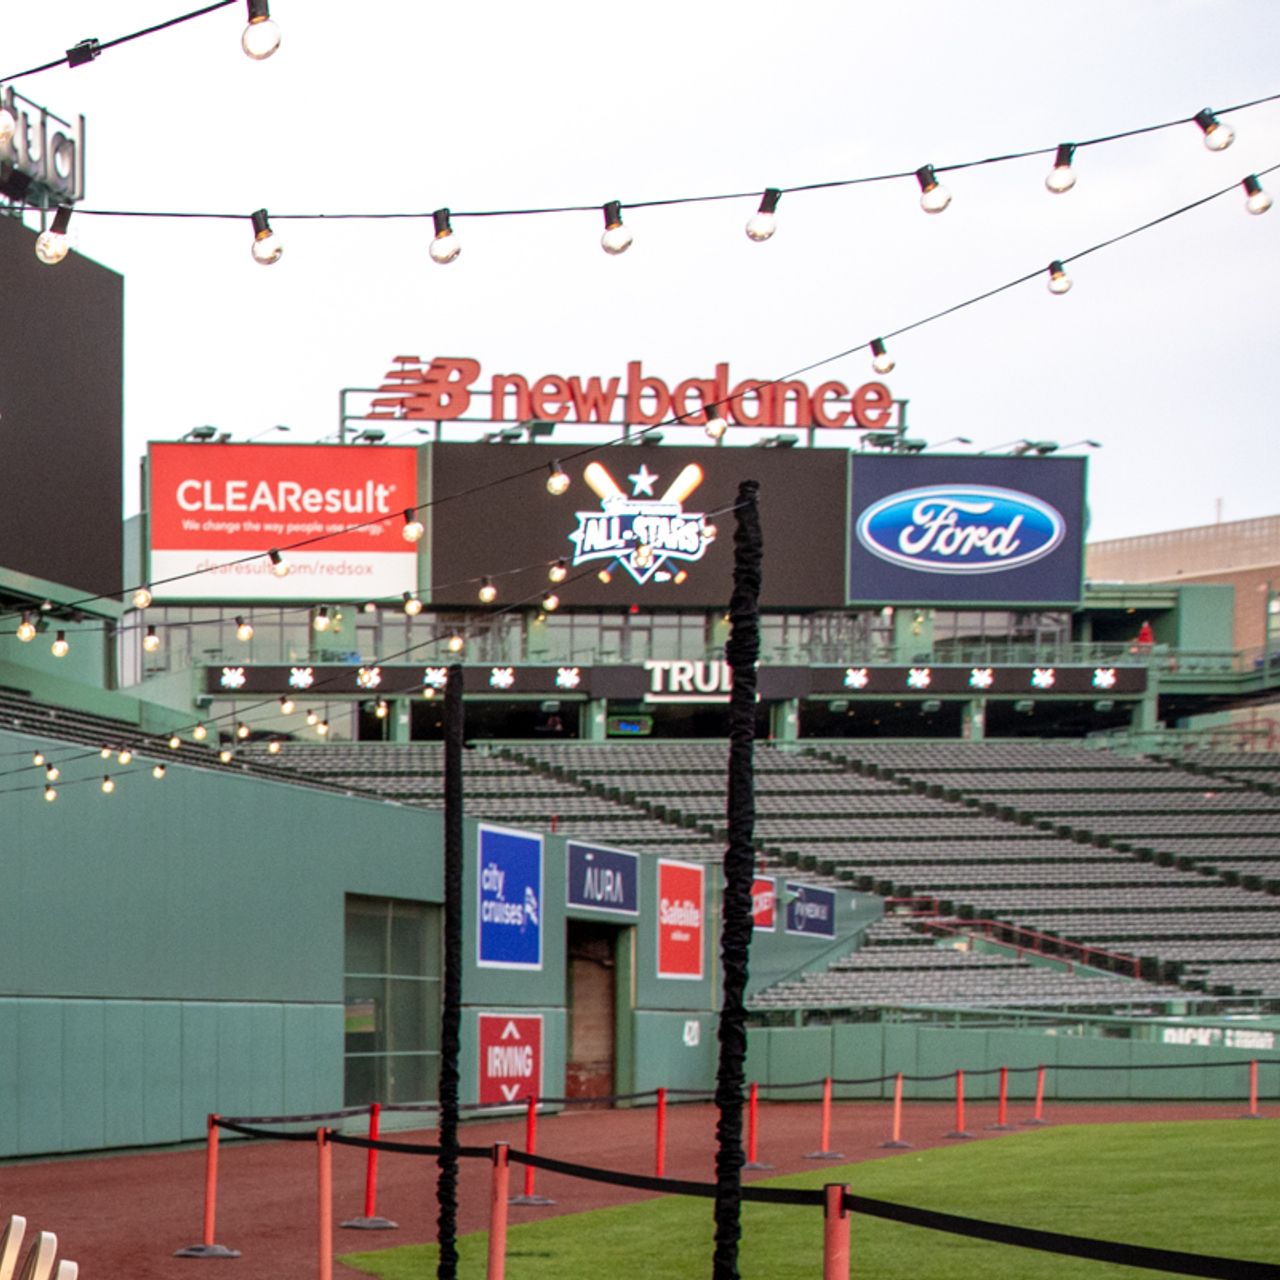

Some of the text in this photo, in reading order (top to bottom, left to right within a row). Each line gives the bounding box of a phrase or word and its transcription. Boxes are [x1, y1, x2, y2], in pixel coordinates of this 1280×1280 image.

[491, 360, 893, 429] new balance
[181, 519, 200, 531] We
[202, 519, 241, 534] change
[243, 519, 262, 531] the
[263, 522, 284, 535] way
[286, 521, 324, 535] people
[326, 522, 344, 533] use
[897, 497, 1025, 557] Ford
[195, 558, 374, 577] clearesultom/redsox
[643, 660, 761, 692] TRUL
[482, 862, 505, 901] city
[583, 866, 624, 904] AURA
[482, 900, 523, 926] cruises
[660, 898, 700, 928] Safelite
[487, 1044, 533, 1078] IRVING
